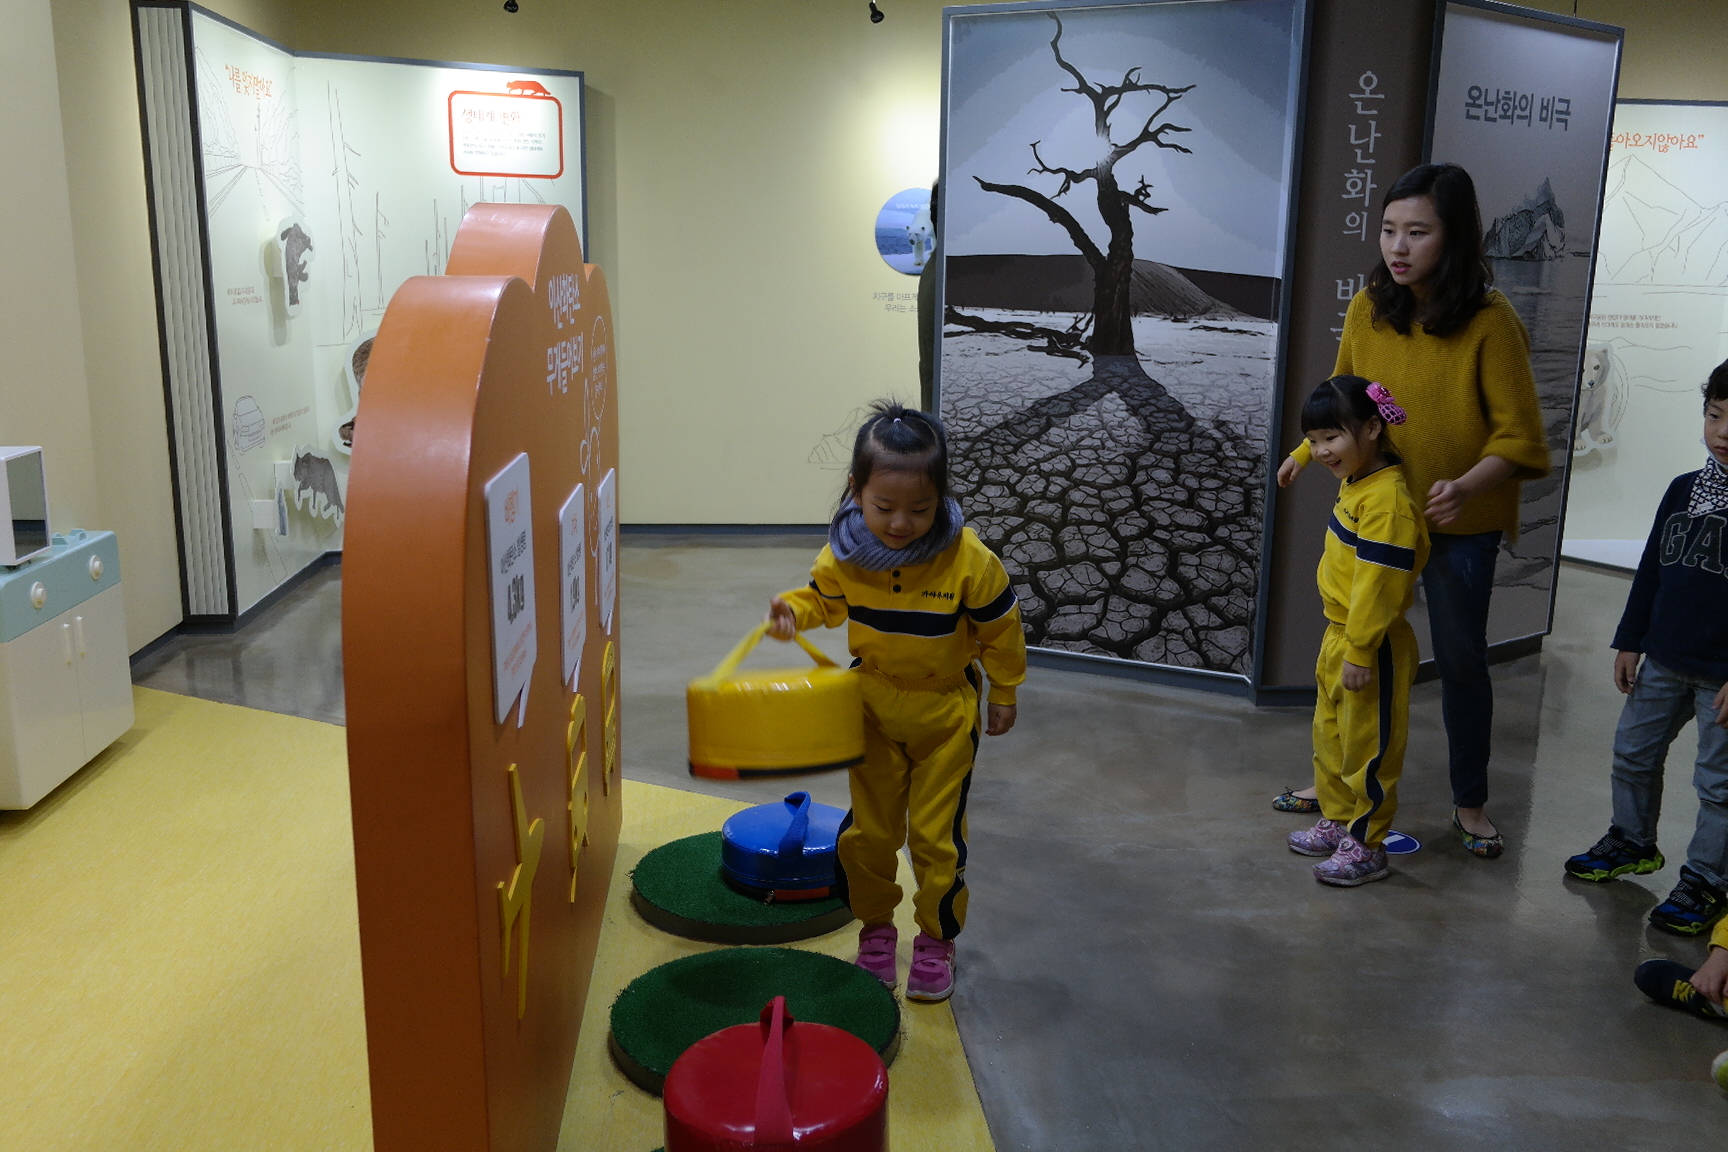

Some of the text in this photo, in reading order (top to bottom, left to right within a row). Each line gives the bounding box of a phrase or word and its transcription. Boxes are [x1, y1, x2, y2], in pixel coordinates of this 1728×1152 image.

[1464, 84, 1572, 132] 온난화의 비극
[1341, 70, 1385, 242] 온난화의
[548, 272, 581, 329] 이산화탄소
[872, 292, 895, 302] 지구를
[884, 303, 907, 313] 우리는
[1660, 511, 1728, 579] GA
